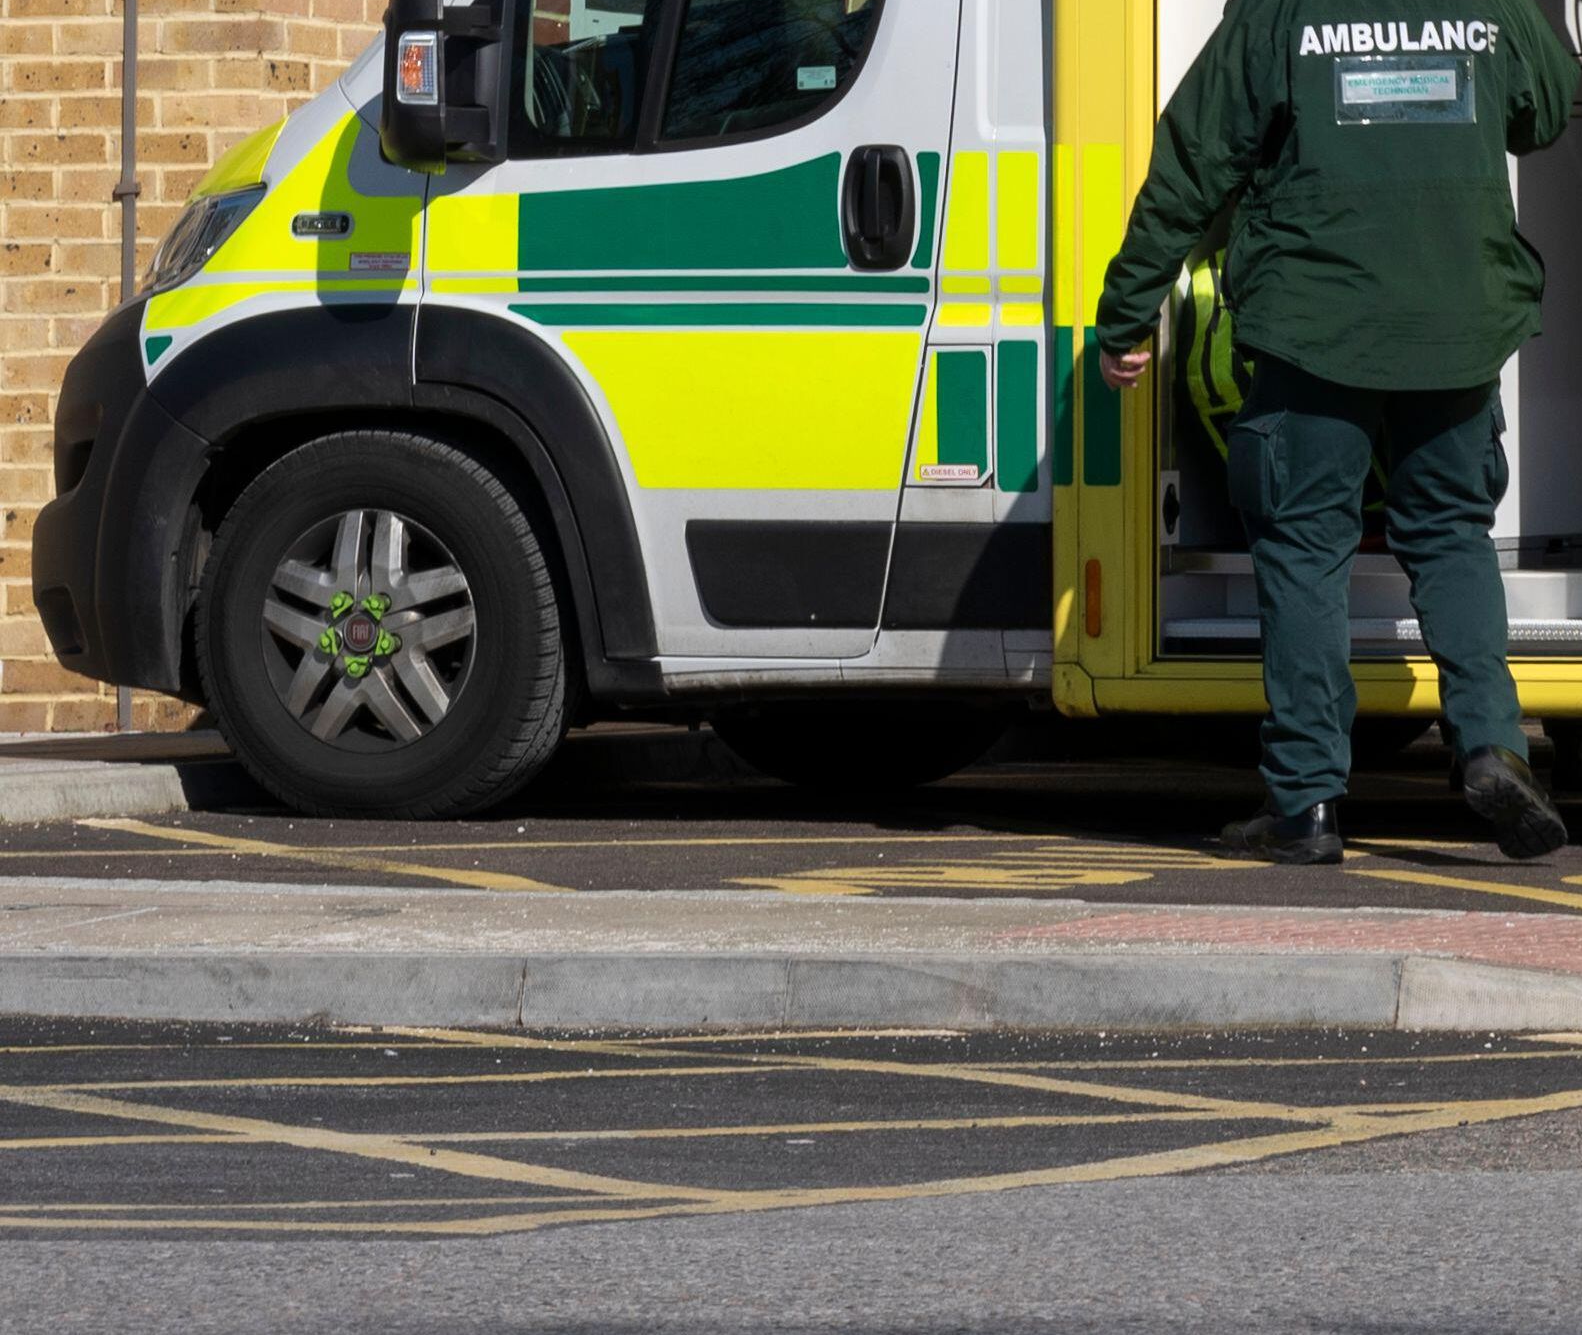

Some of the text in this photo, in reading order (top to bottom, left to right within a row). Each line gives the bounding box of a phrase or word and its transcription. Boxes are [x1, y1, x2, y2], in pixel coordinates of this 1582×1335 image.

[1299, 20, 1499, 56] AMBULANCE
[1347, 75, 1450, 88] EMERGENCY MEDICAL
[1372, 86, 1430, 96] TECHNICIAN
[930, 468, 977, 476] DIESEL ONLY
[352, 624, 369, 641] FIAT
